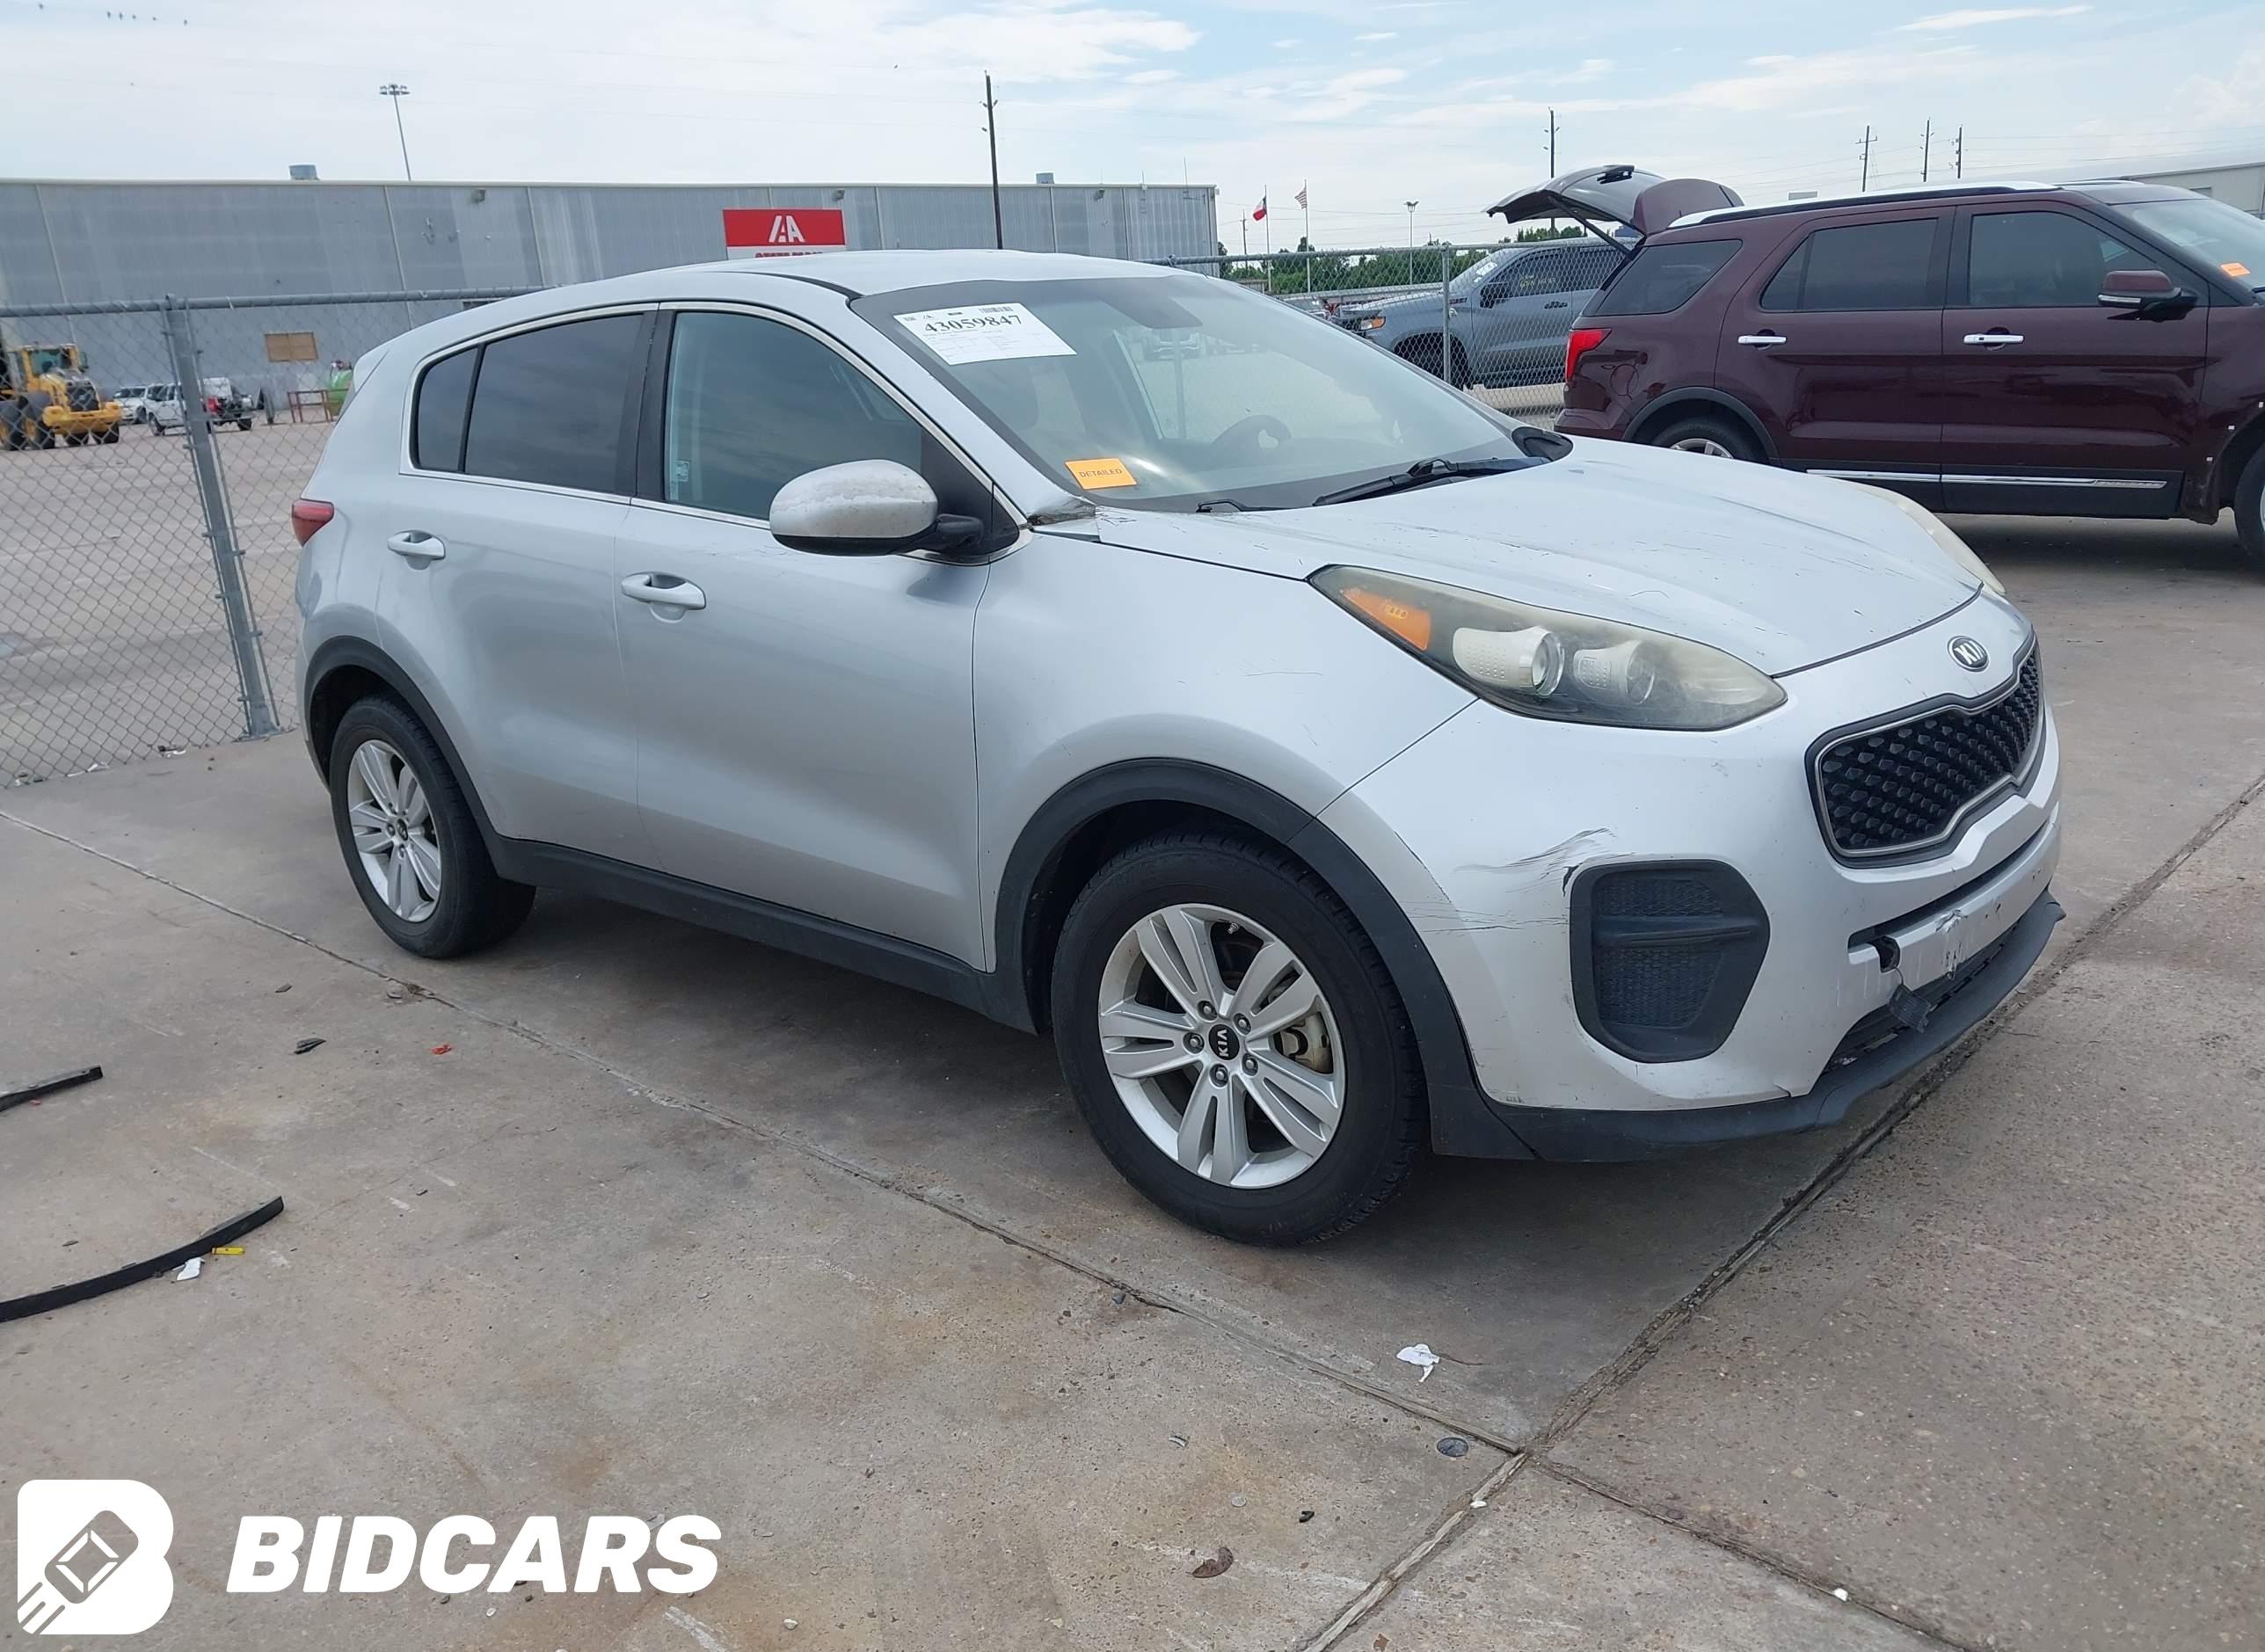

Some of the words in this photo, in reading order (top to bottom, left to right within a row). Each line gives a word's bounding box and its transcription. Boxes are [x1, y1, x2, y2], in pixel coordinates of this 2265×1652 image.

[924, 315, 1023, 333] 43059847
[1079, 469, 1123, 477] DETAILED
[1954, 640, 1985, 666] KIA
[1217, 1029, 1229, 1058] KIA
